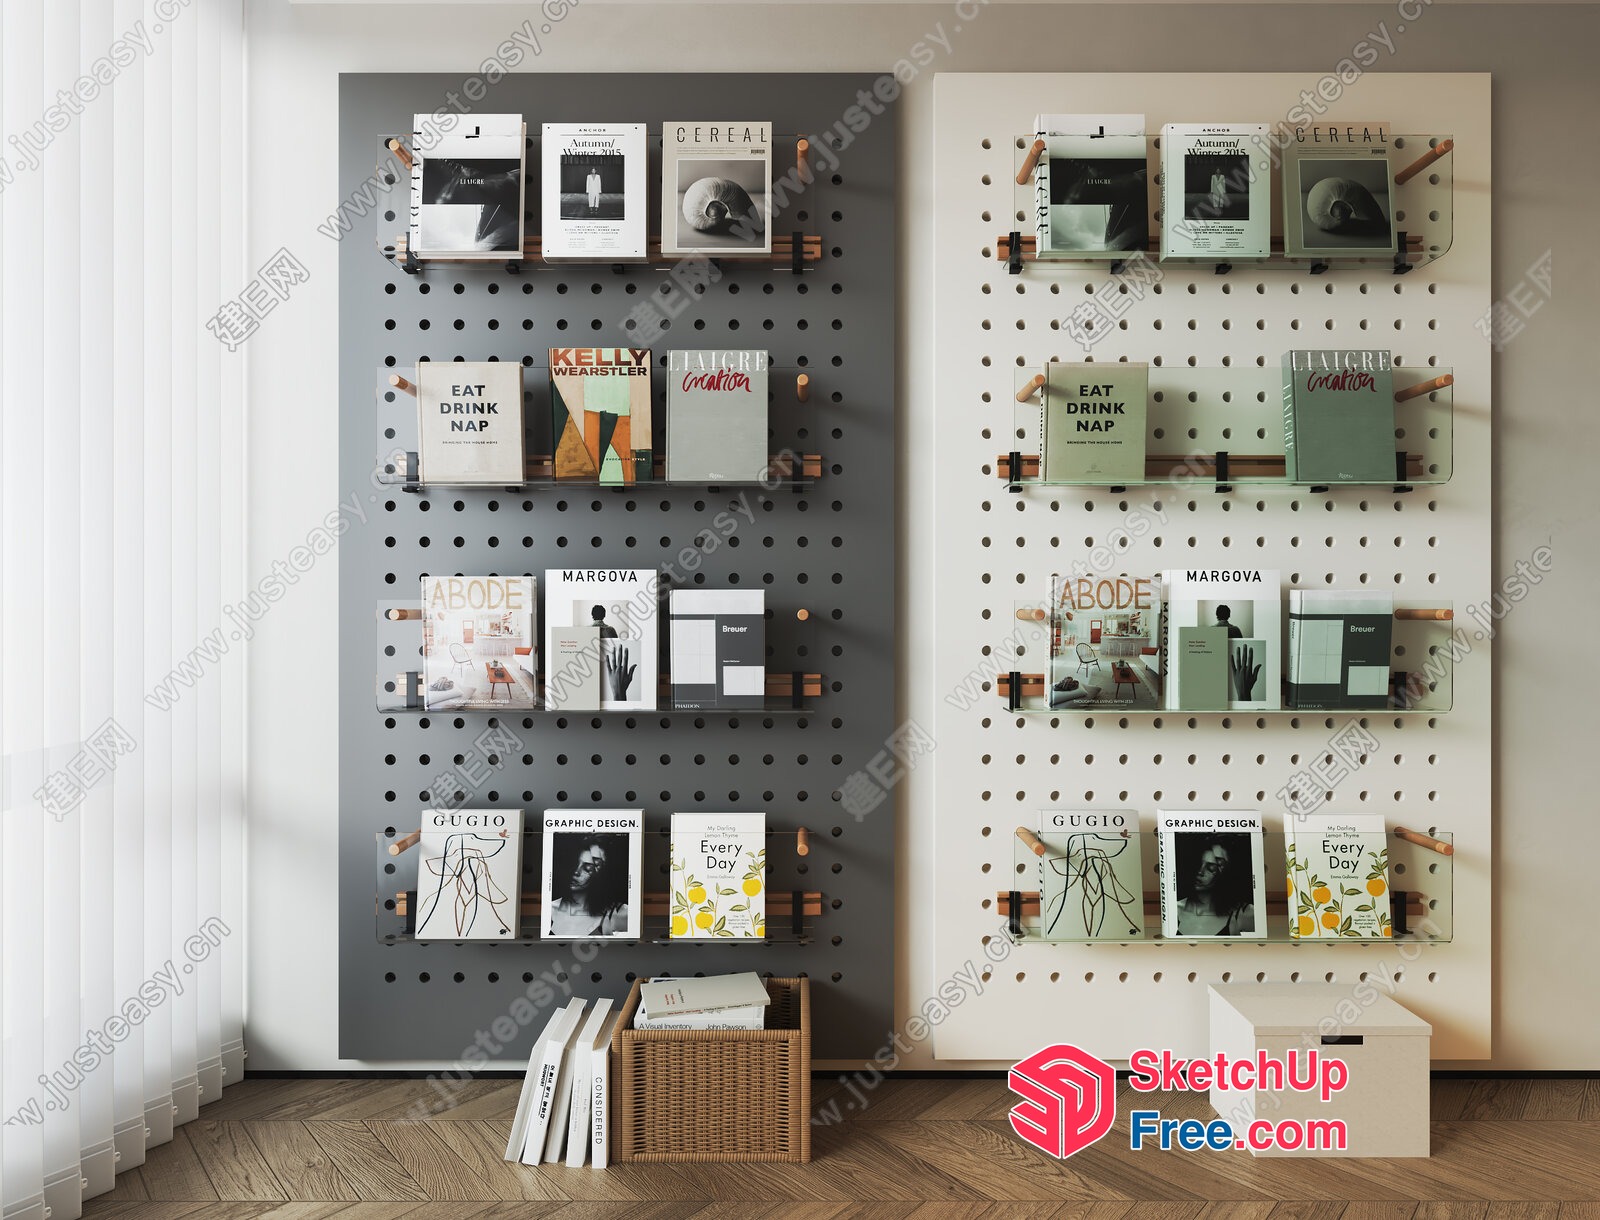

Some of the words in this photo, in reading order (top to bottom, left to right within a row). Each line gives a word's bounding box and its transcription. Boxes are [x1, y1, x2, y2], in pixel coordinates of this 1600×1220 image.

[676, 127, 768, 143] CEREAL
[1295, 127, 1388, 143] CEREAL
[570, 138, 616, 148] Autumn/
[1194, 138, 1240, 148] Autumn/
[600, 148, 621, 156] 2015
[1224, 148, 1246, 156] 2015
[552, 348, 650, 366] KELLY
[669, 351, 768, 372] LIAIGRE
[1292, 351, 1391, 371] LIAIGRE
[553, 367, 647, 376] WEARSTLER
[452, 385, 485, 396] EAT
[1079, 385, 1114, 397] EAT
[440, 402, 498, 414] DRINK
[1066, 402, 1125, 414] DRINK
[451, 420, 489, 432] NAP
[1076, 420, 1115, 432] NAP
[562, 570, 638, 582] MARGOVA
[1186, 570, 1262, 582] MARGOVA
[430, 578, 522, 610] ABODE
[1059, 578, 1152, 610] ABODE
[433, 815, 505, 827] GUGIO
[545, 819, 593, 828] GRAPHIC
[597, 819, 639, 828] DESIGN.
[1052, 815, 1125, 827] GUGIO
[1165, 819, 1213, 828] GRAPHIC
[1217, 819, 1260, 828] DESIGN.
[701, 840, 743, 857] Every
[1322, 840, 1365, 857] Every
[707, 856, 737, 873] Day
[1329, 856, 1359, 873] Day
[595, 1076, 603, 1145] CONSIDERED
